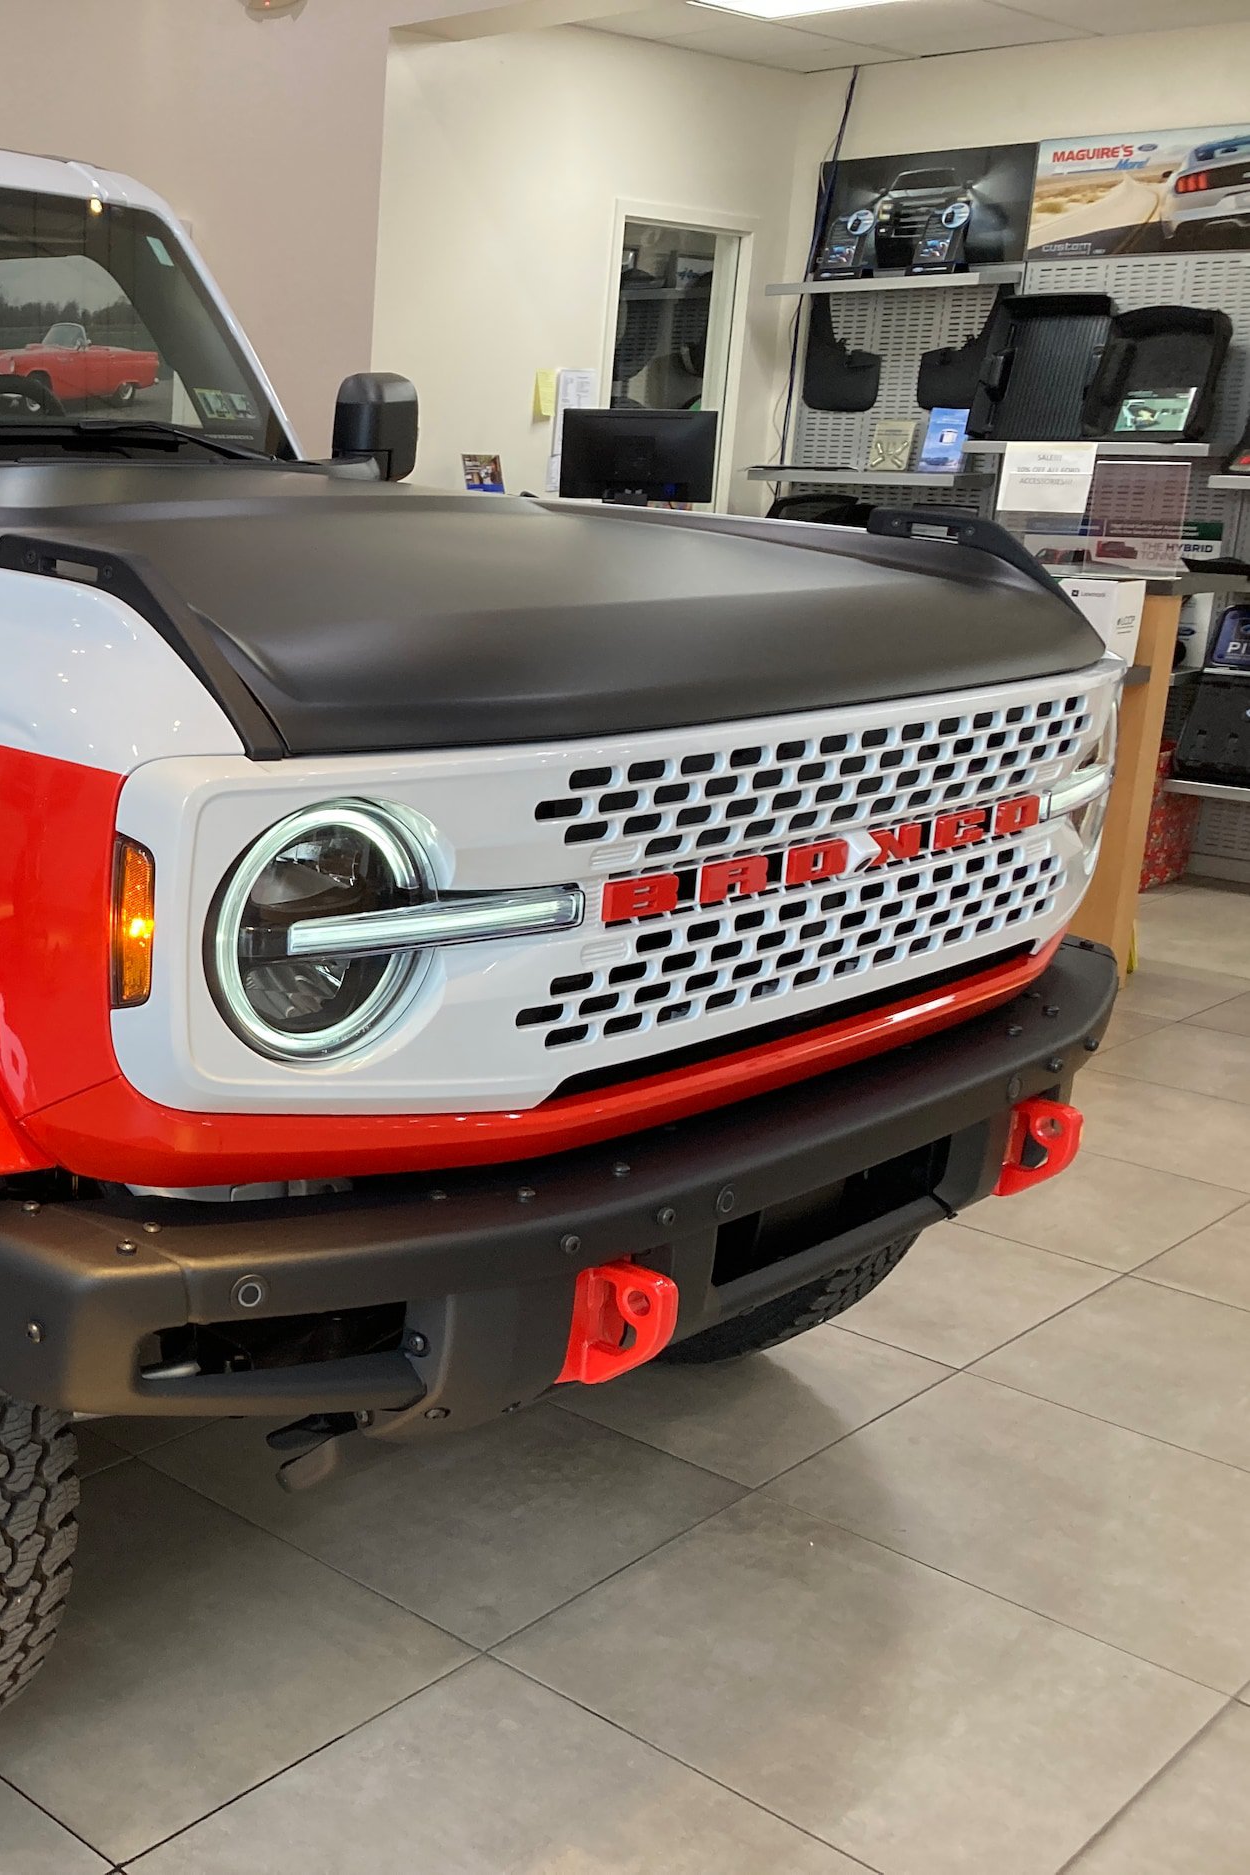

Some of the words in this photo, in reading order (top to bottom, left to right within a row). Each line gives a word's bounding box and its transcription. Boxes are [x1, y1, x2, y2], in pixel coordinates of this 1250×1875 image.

[1052, 144, 1135, 163] MAGUIRE'S
[1042, 242, 1092, 256] custom
[1142, 541, 1164, 551] THE
[1166, 543, 1213, 553] HYBRID
[601, 795, 1040, 922] BRONCO
